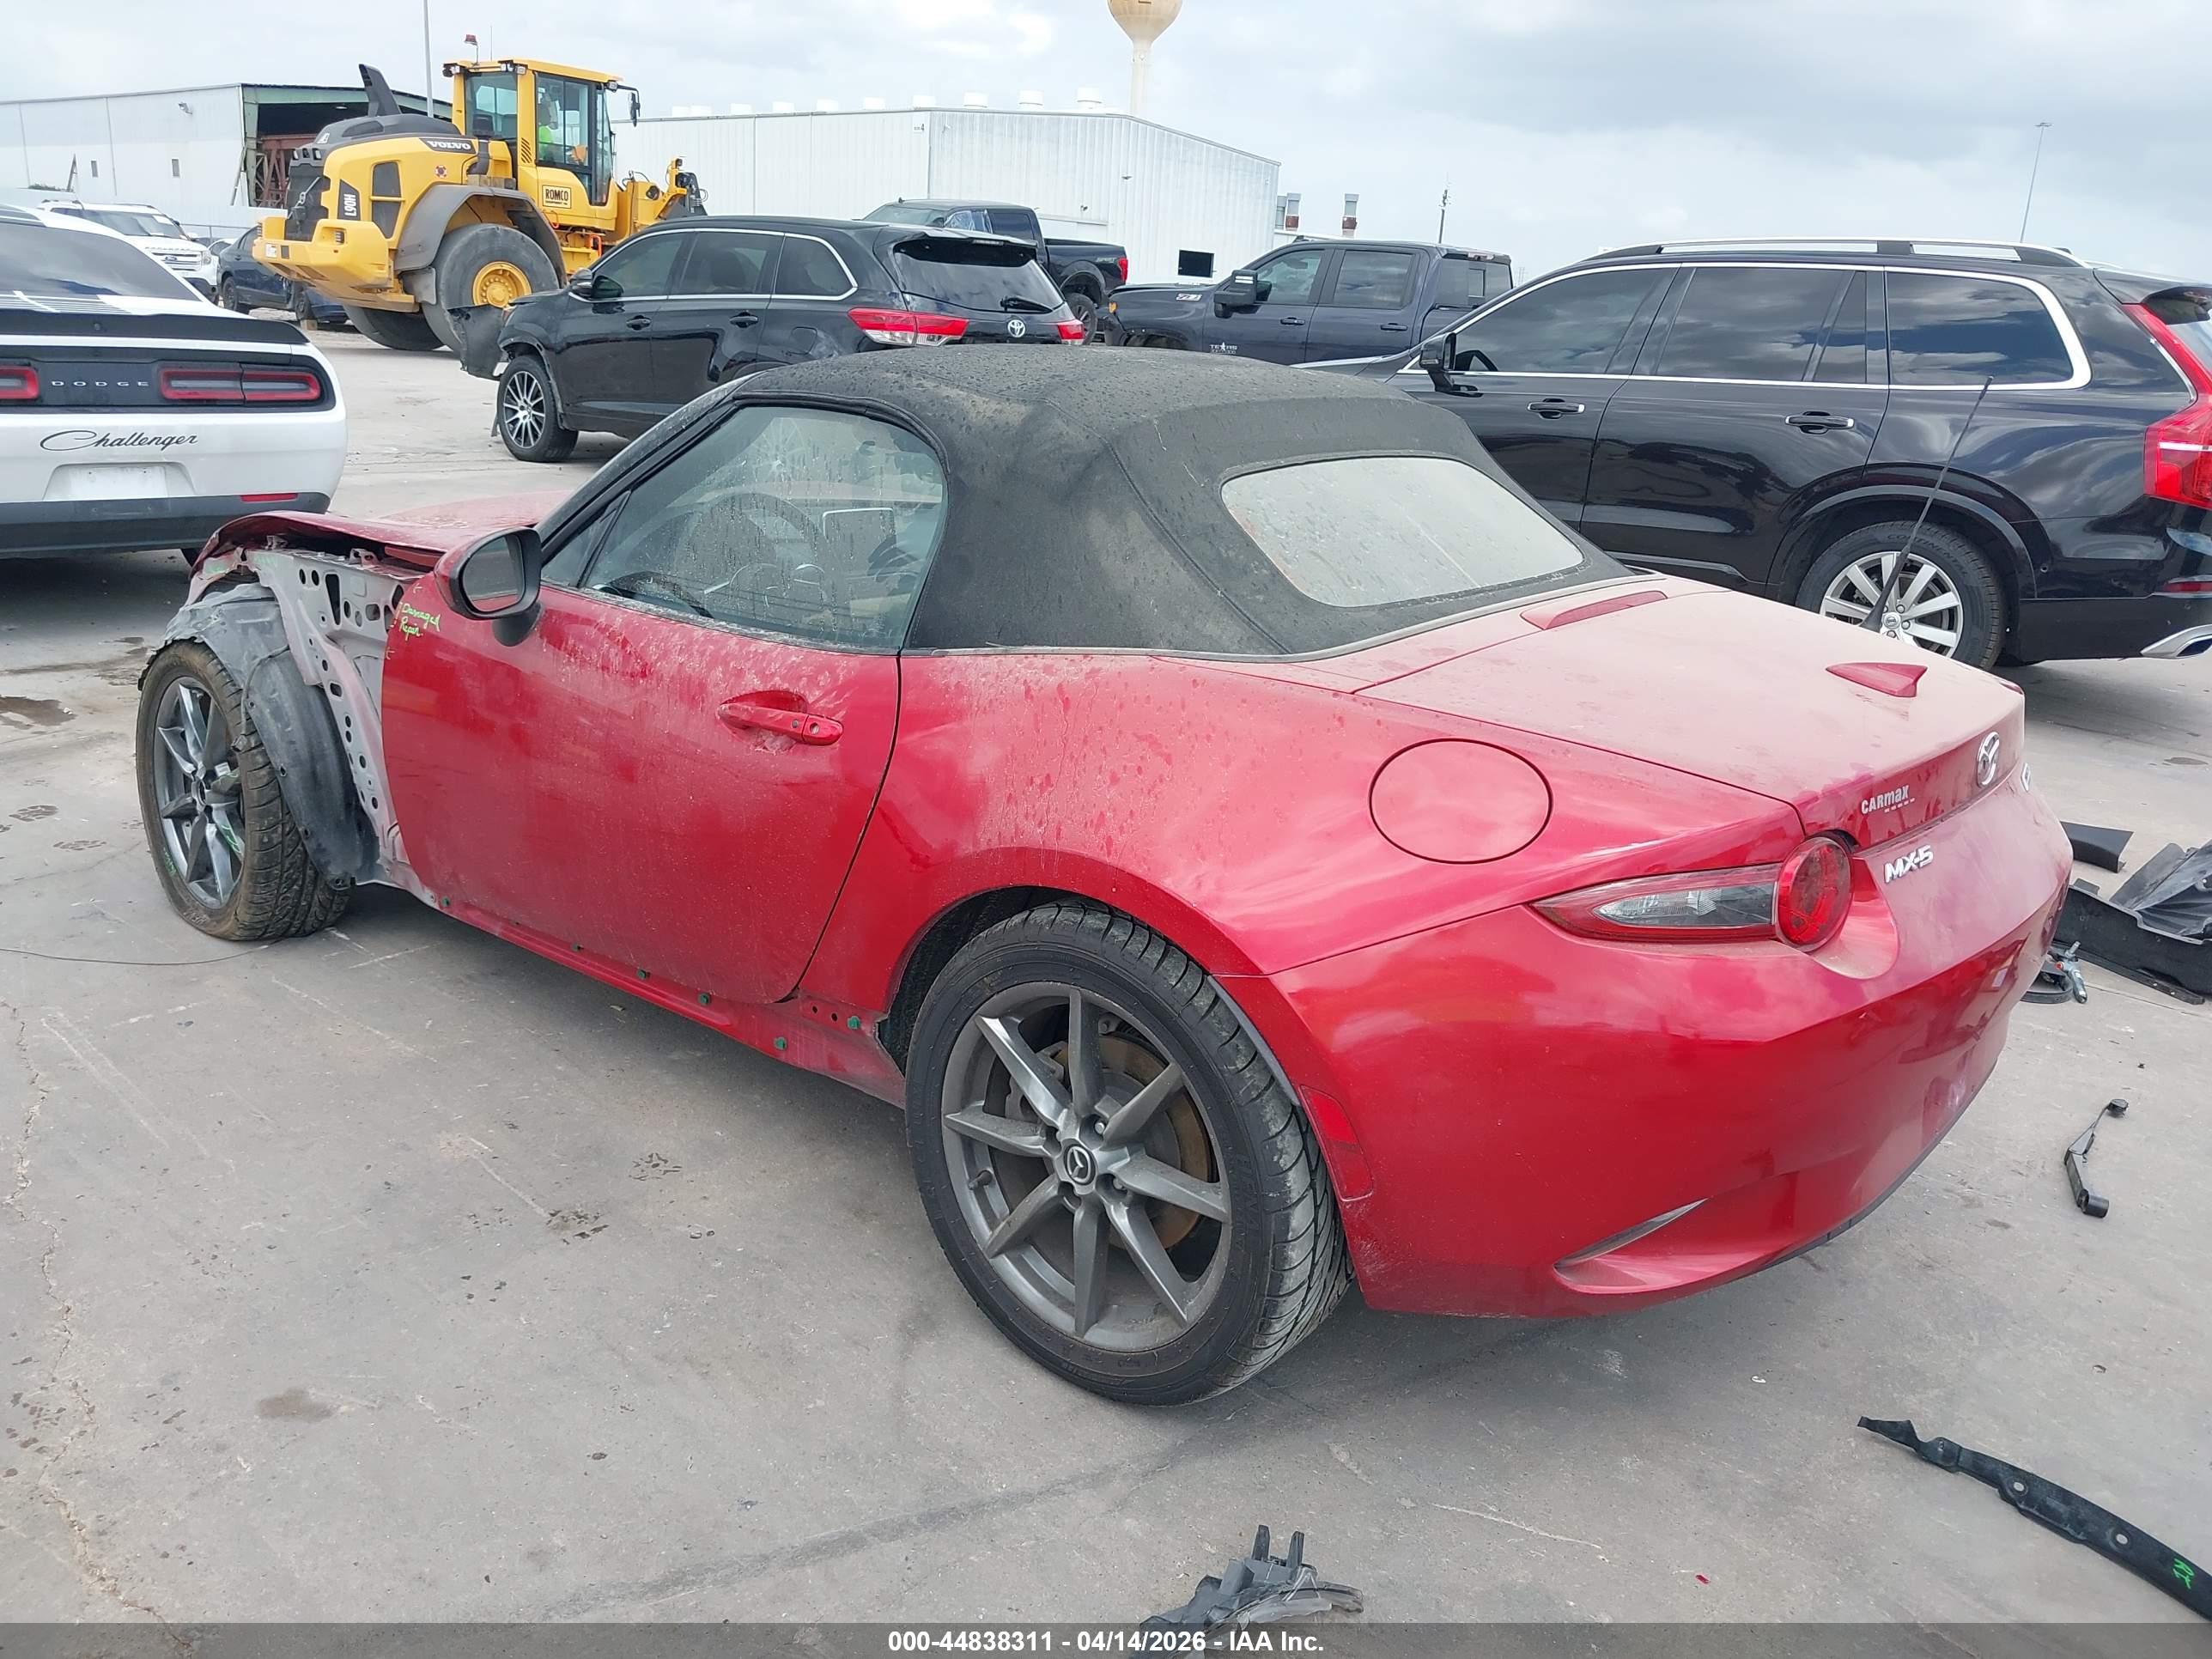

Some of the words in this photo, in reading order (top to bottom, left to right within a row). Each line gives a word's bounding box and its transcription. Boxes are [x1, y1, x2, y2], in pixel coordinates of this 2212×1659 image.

[427, 140, 471, 149] VOLVO
[344, 194, 357, 216] L90H
[545, 188, 568, 201] ROMCO
[40, 430, 198, 451] Challenger
[1884, 845, 1934, 884] MX-5
